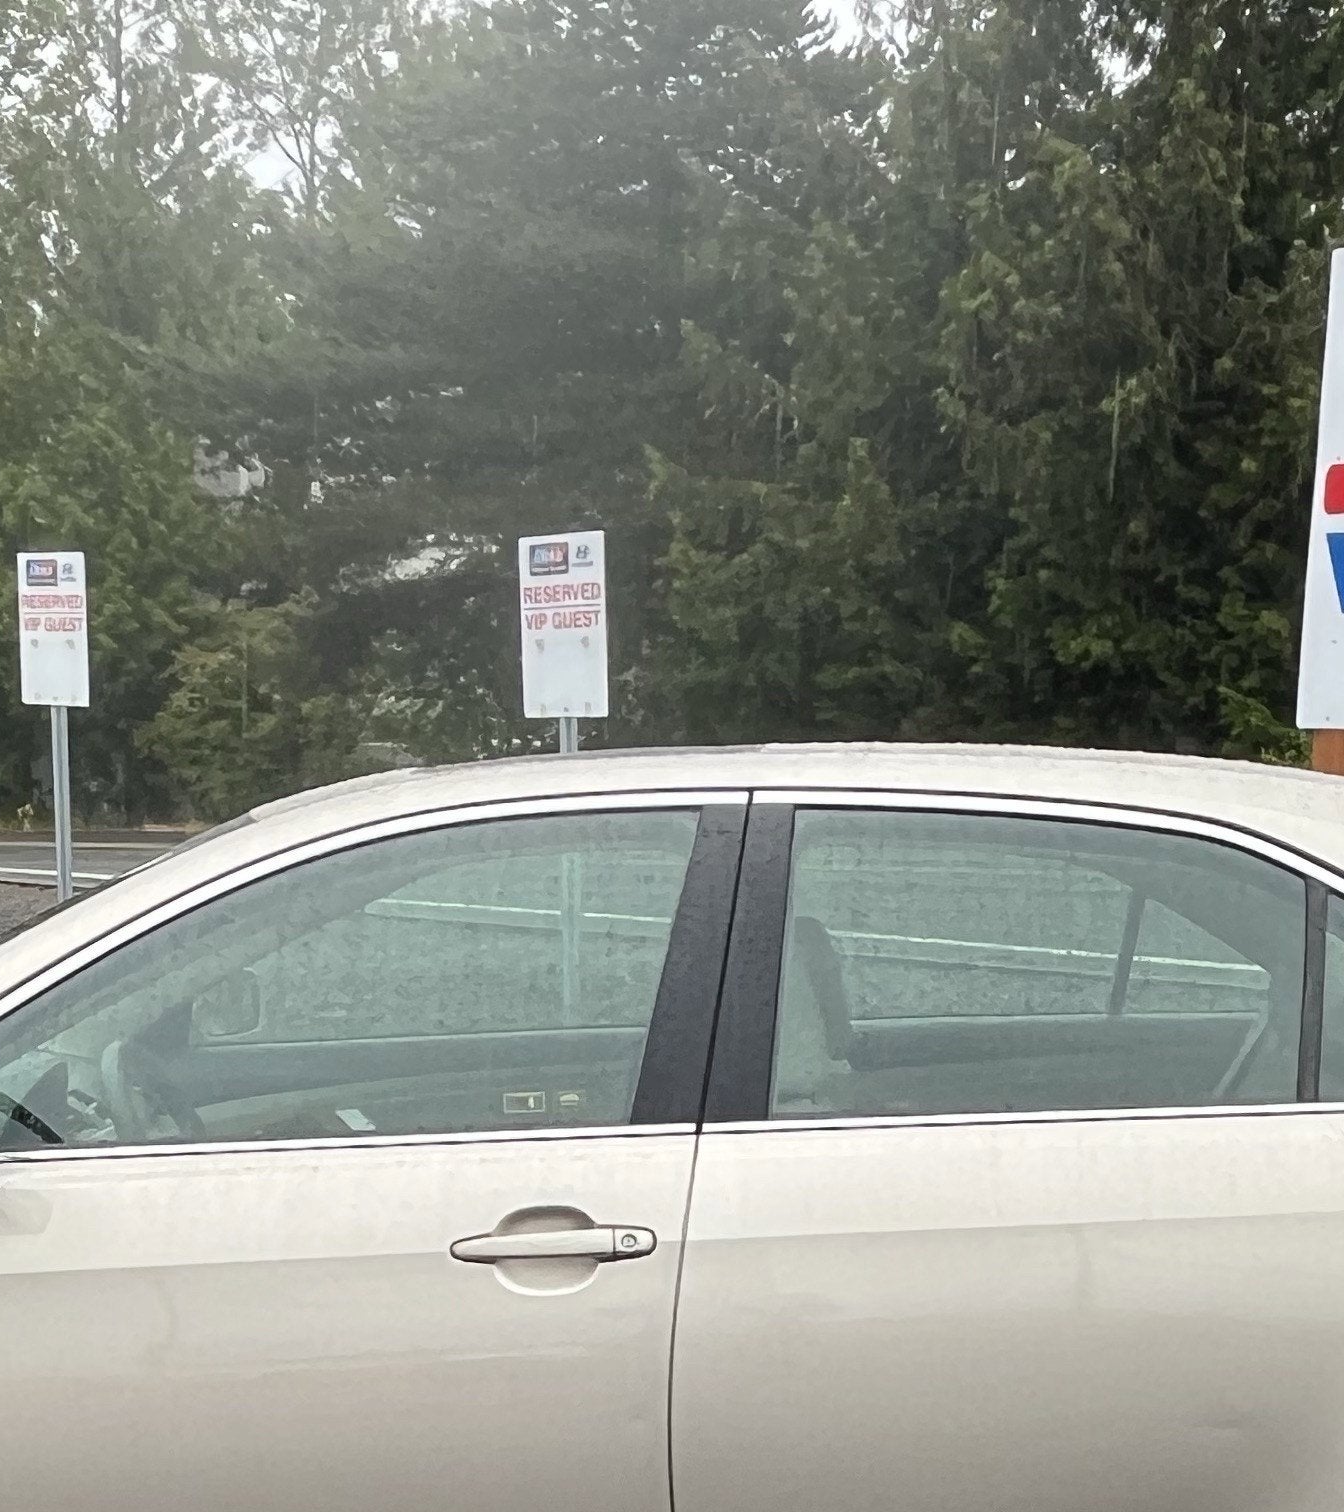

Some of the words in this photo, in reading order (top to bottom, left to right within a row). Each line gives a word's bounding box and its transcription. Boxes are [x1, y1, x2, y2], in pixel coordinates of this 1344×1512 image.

[524, 582, 601, 604] RESERVED
[524, 612, 548, 630] VIP
[552, 610, 601, 629] GUEST
